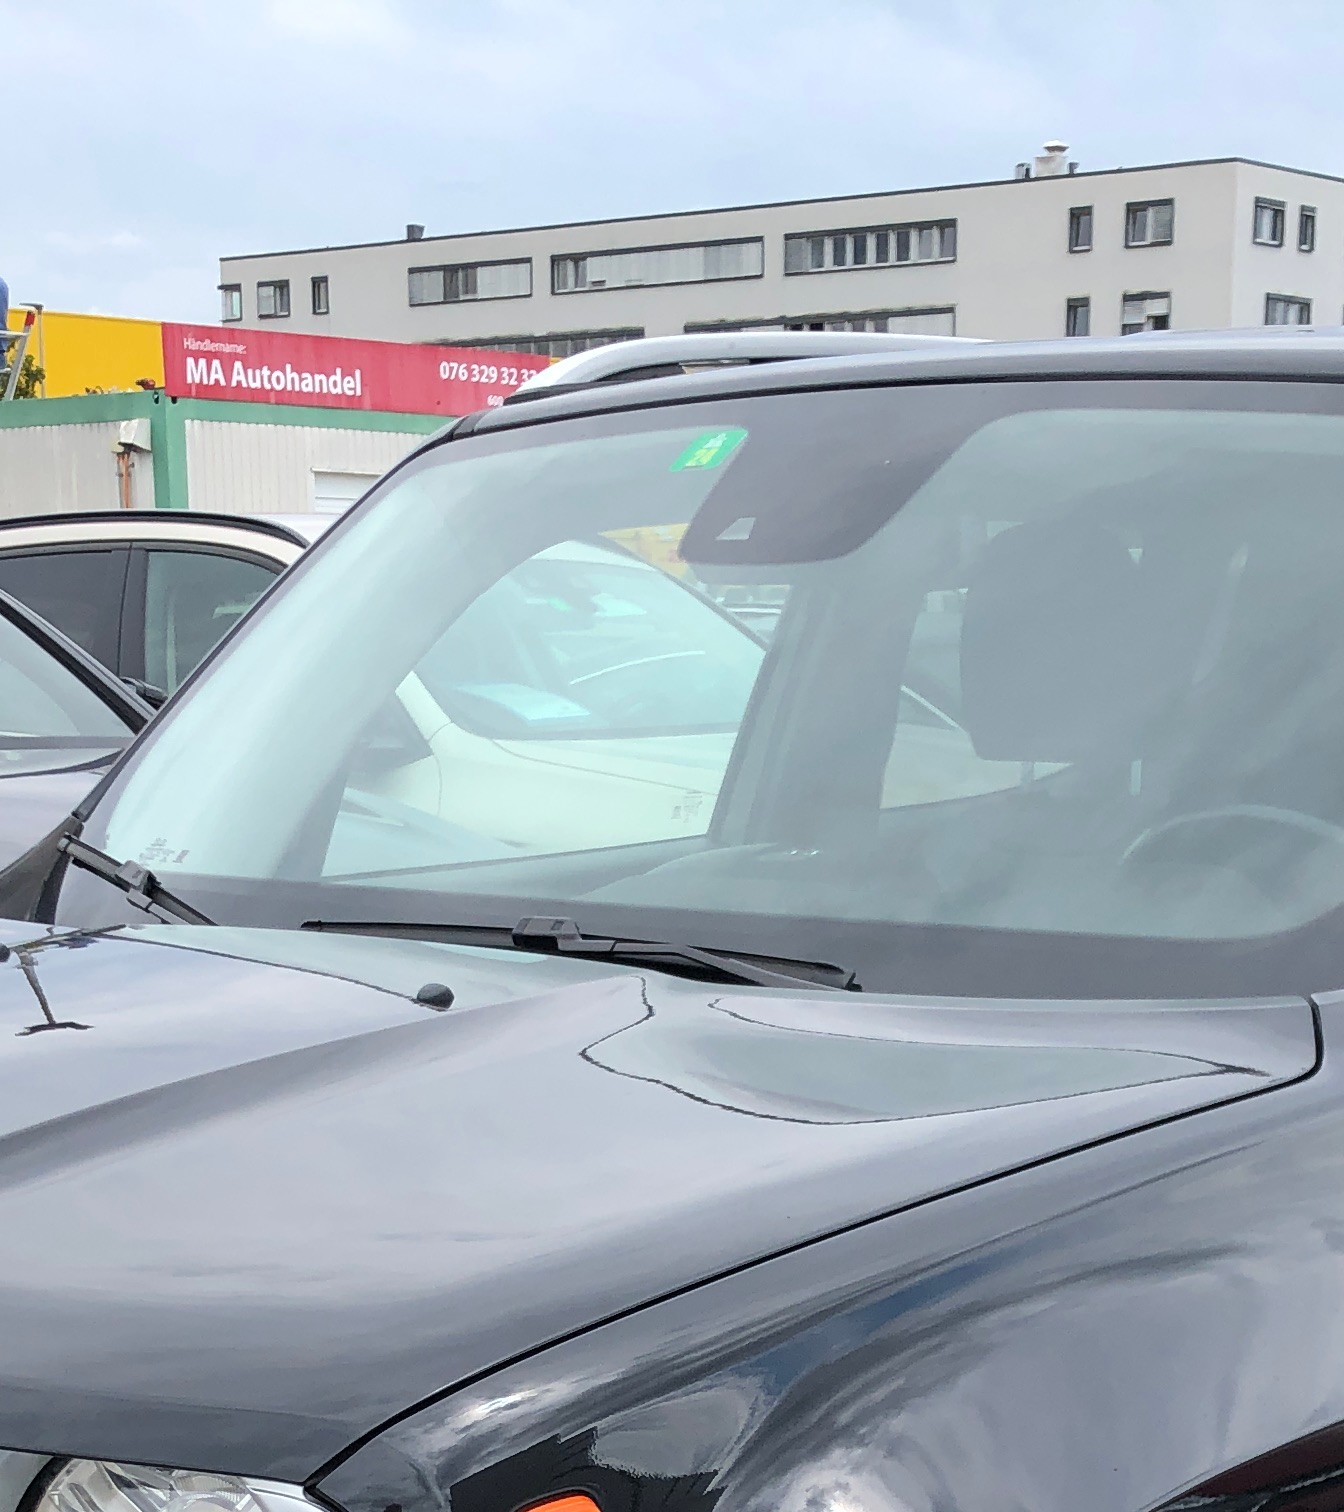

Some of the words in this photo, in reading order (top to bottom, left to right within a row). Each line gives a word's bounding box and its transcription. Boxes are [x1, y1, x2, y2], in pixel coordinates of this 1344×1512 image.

[186, 356, 226, 386] MA
[231, 360, 362, 397] Autohandel
[439, 360, 469, 381] 076
[470, 364, 498, 384] 329
[500, 366, 518, 386] 32
